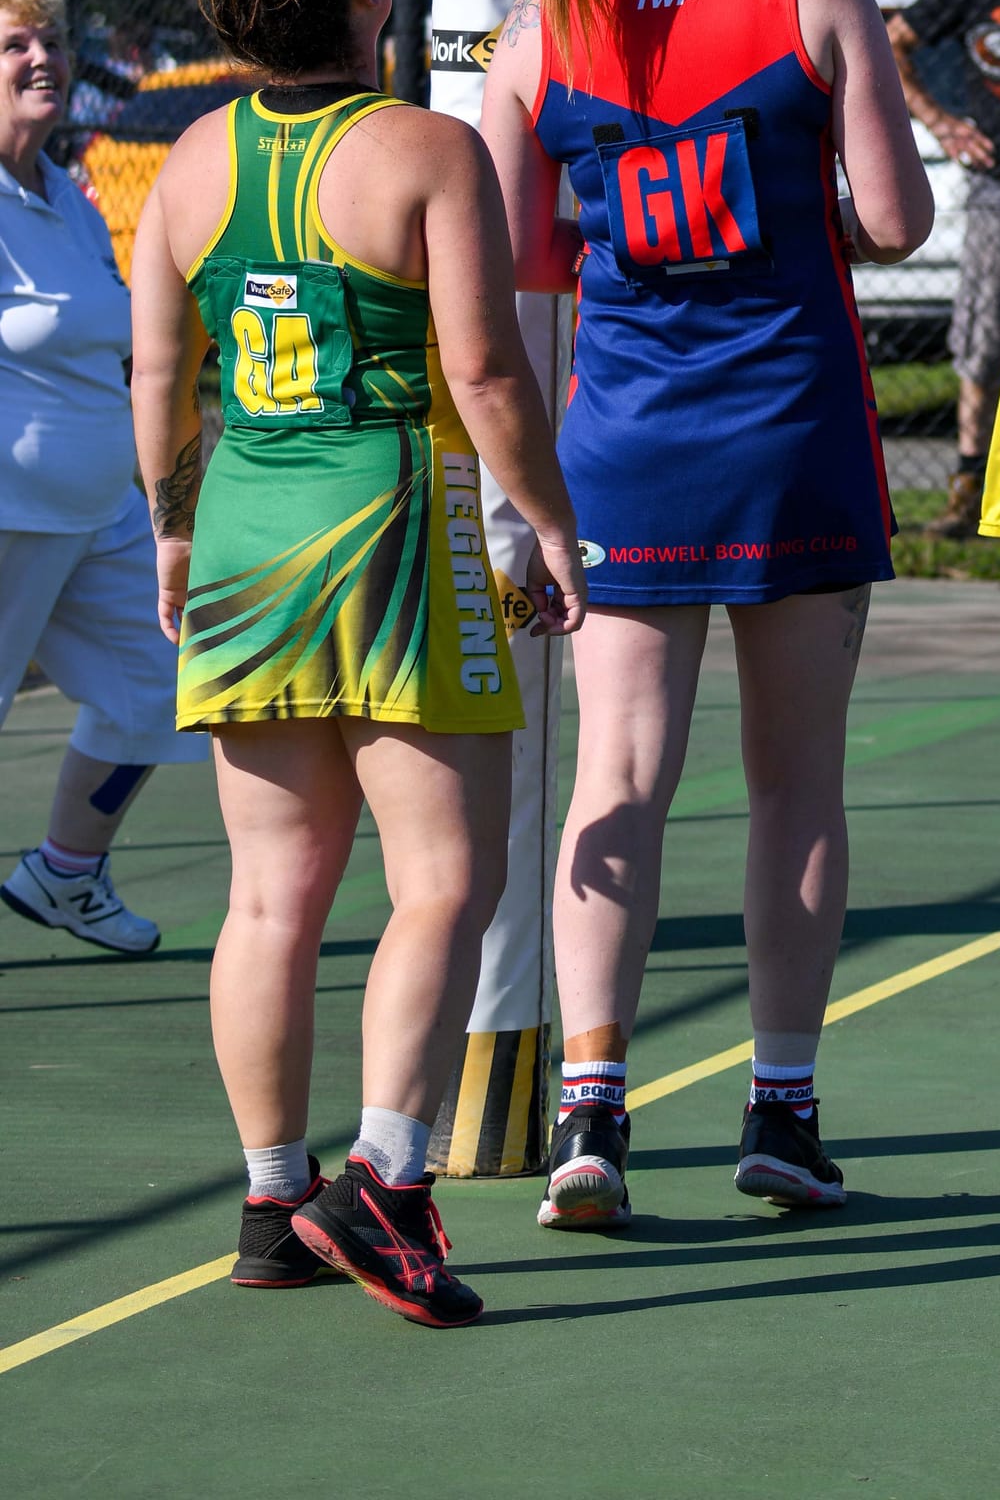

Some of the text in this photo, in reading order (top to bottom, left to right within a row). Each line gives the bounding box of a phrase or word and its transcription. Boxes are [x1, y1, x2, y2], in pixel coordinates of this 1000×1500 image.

[617, 132, 748, 266] GK
[231, 306, 324, 417] GA
[609, 534, 858, 563] MORWELL BOWLING CLUB
